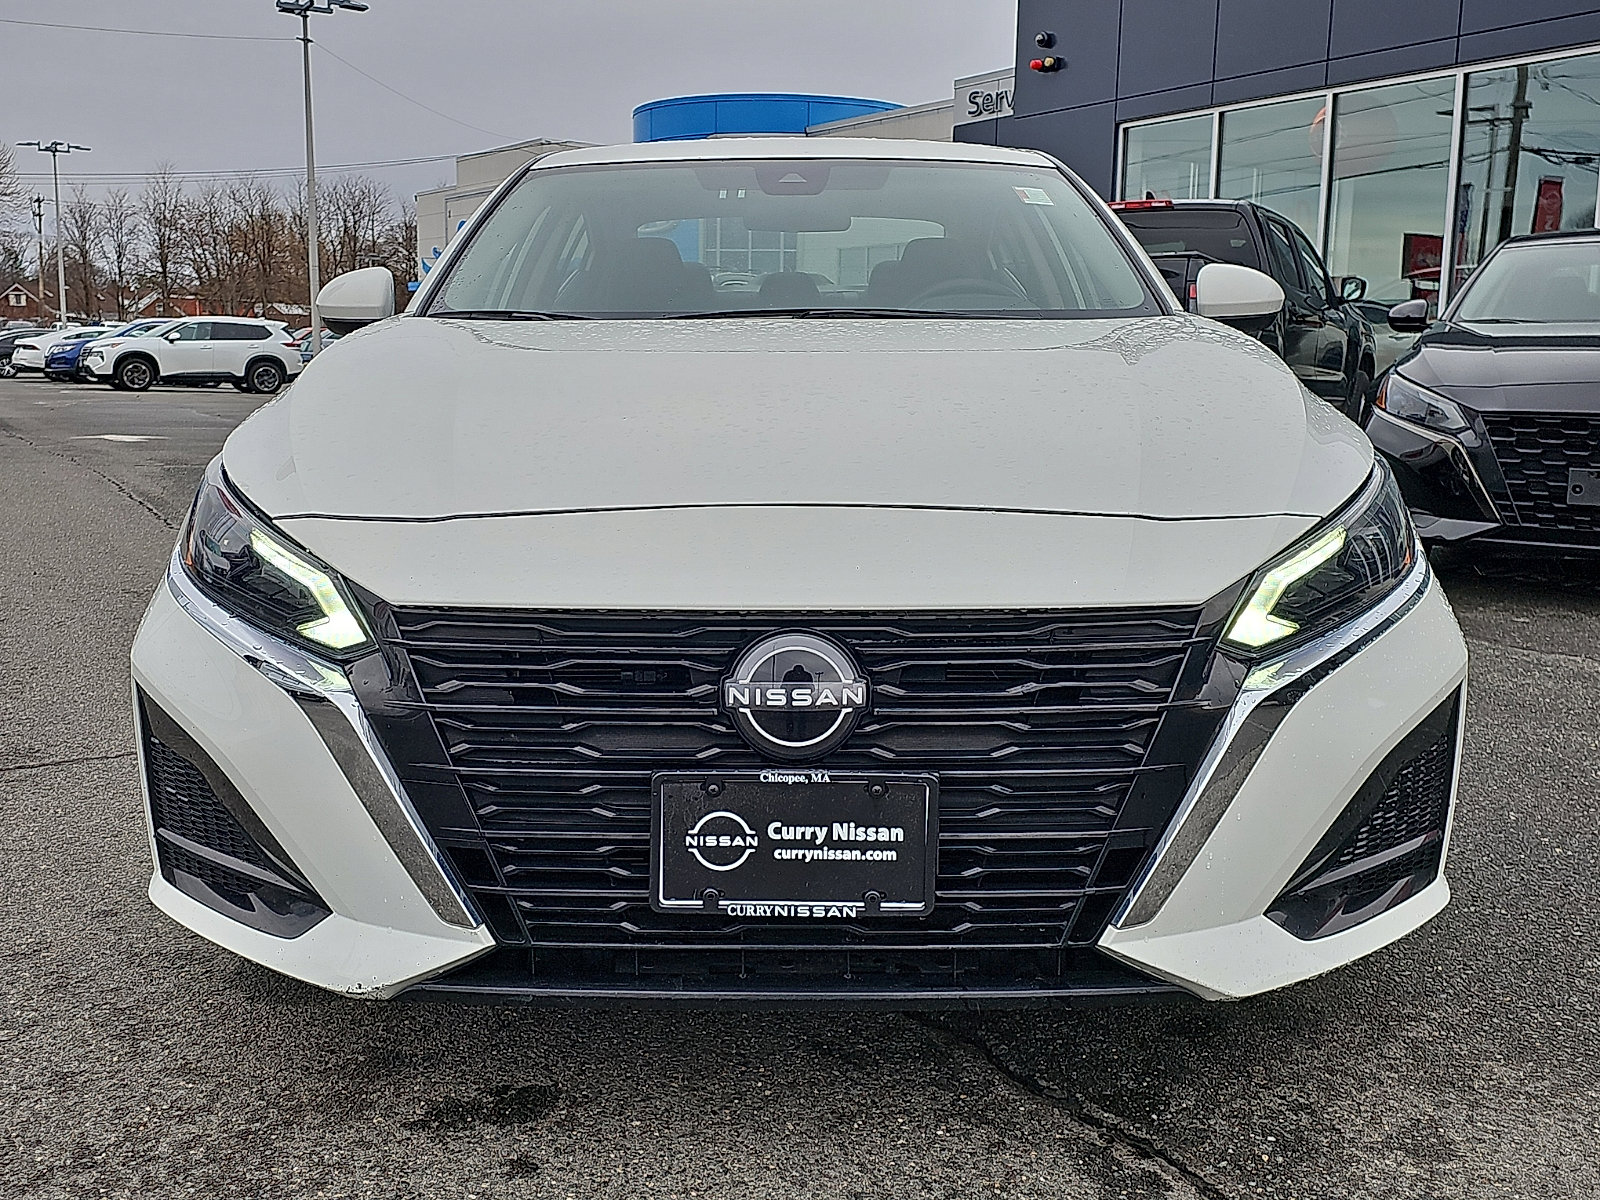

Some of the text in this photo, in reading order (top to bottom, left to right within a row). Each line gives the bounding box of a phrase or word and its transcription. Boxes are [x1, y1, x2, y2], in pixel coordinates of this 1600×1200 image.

[727, 686, 864, 707] NISSAN
[760, 772, 831, 785] Chicopee, MA
[685, 835, 759, 847] NISSAN
[767, 822, 904, 845] Curry Nissan
[773, 846, 897, 863] currynissan.com
